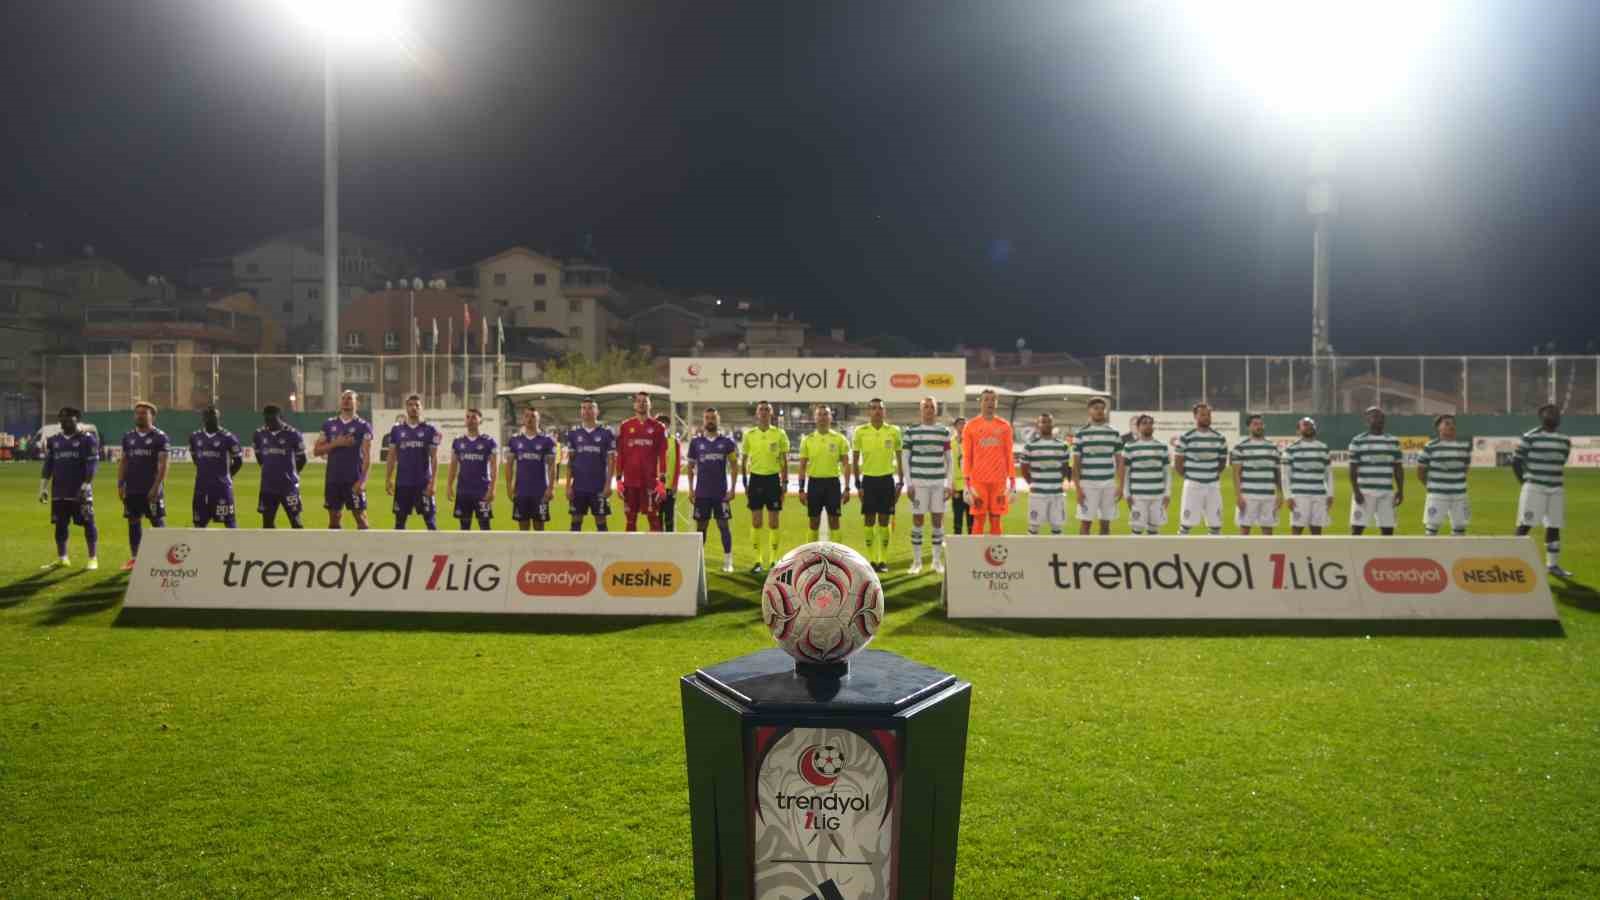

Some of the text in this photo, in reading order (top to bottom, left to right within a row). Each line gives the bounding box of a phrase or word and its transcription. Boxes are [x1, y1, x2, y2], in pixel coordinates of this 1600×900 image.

[721, 368, 828, 392] trendyol
[150, 567, 198, 578] trendyol
[223, 552, 413, 597] trendyol
[524, 570, 590, 587] trendyol
[971, 568, 1024, 581] trendyol
[1048, 553, 1254, 597] trendyol
[1371, 566, 1441, 585] trendyol
[776, 791, 869, 815] trendyol
